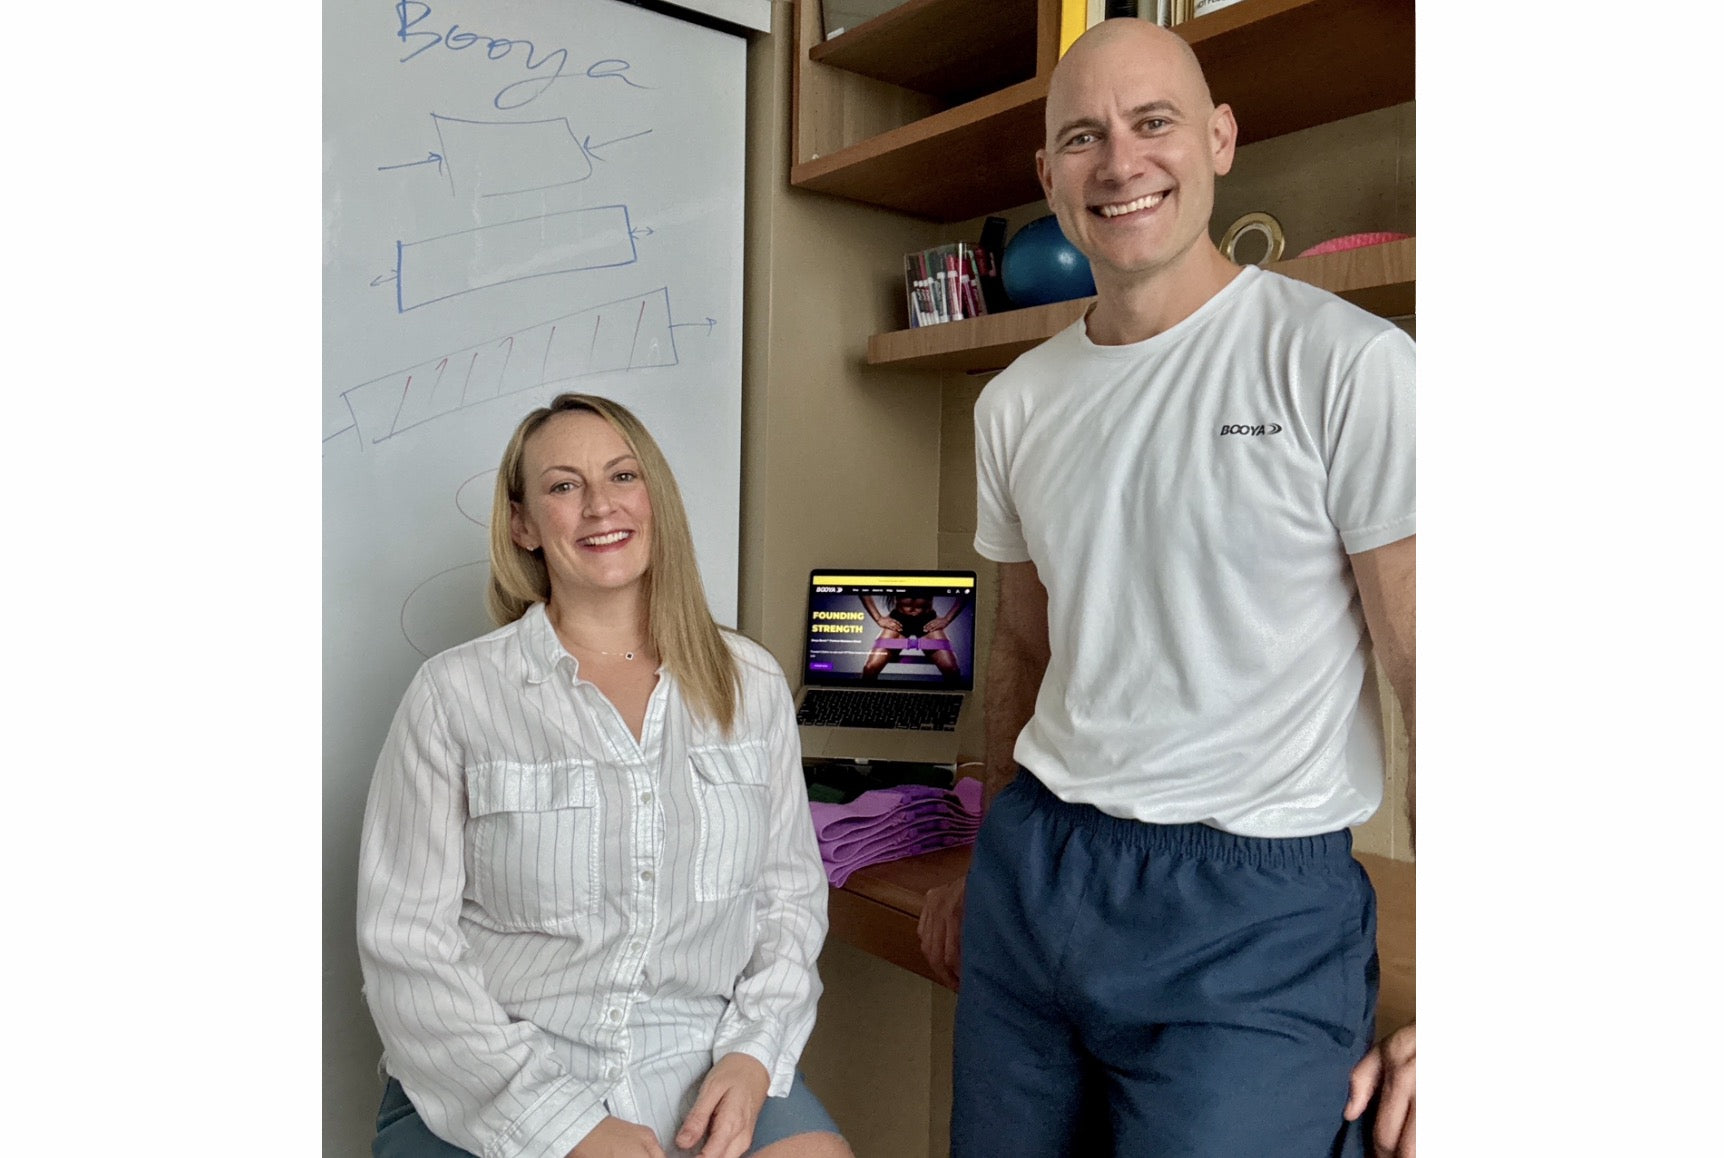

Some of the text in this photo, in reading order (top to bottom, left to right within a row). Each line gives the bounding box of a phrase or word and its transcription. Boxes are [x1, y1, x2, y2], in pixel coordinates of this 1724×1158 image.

[1221, 425, 1265, 436] BOOYA
[813, 612, 865, 621] FOUNDING
[811, 625, 864, 633] STRENGTH
